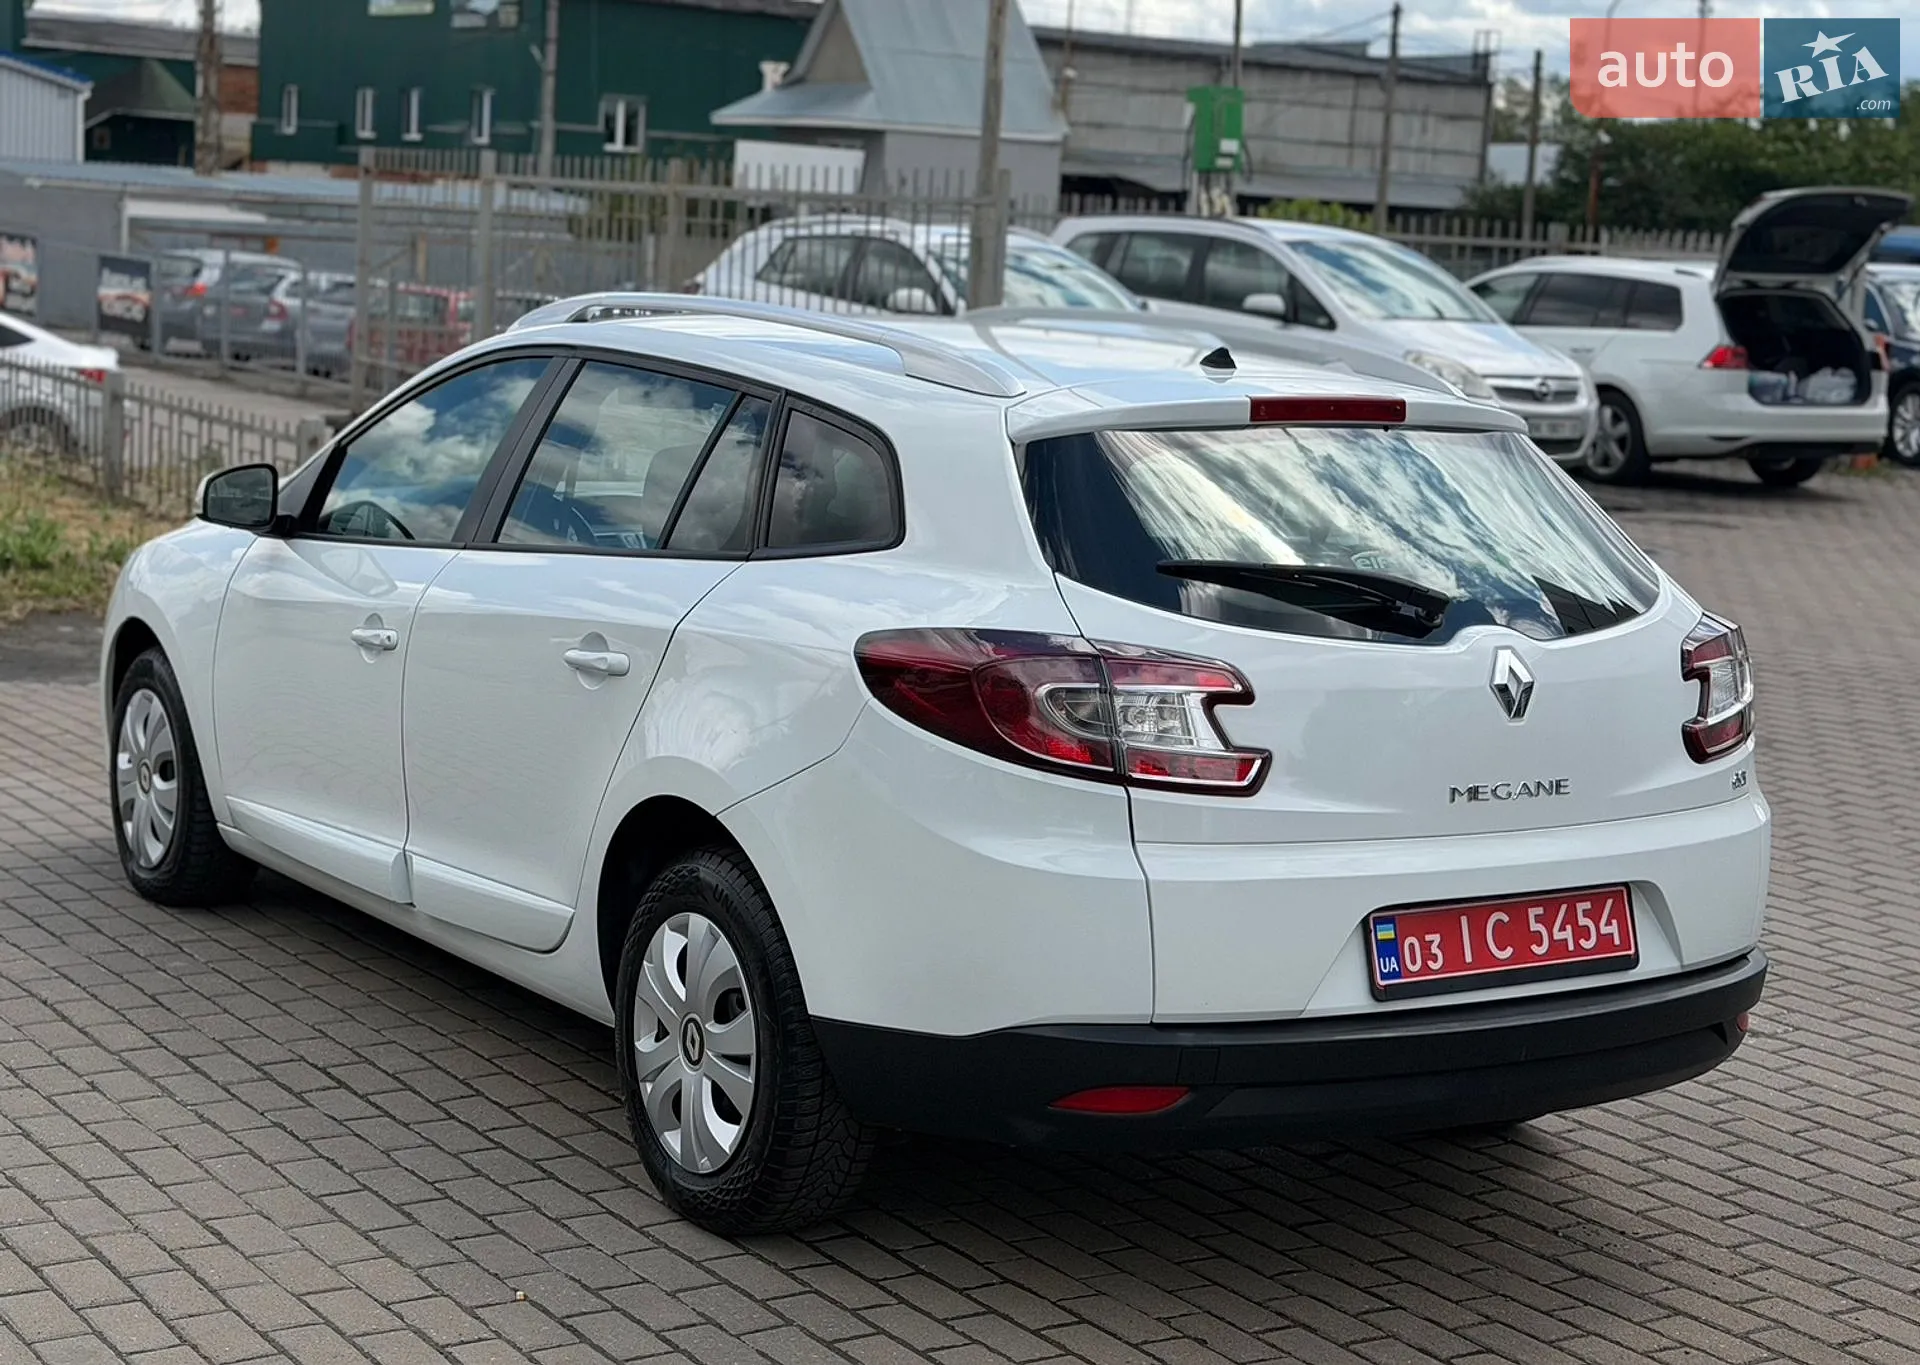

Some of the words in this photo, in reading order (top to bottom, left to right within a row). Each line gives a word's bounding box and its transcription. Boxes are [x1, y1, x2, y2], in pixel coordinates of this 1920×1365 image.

[1449, 778, 1571, 804] MEGANE
[1403, 933, 1445, 973] 03
[1527, 898, 1621, 956] 5454
[1380, 956, 1399, 974] UA
